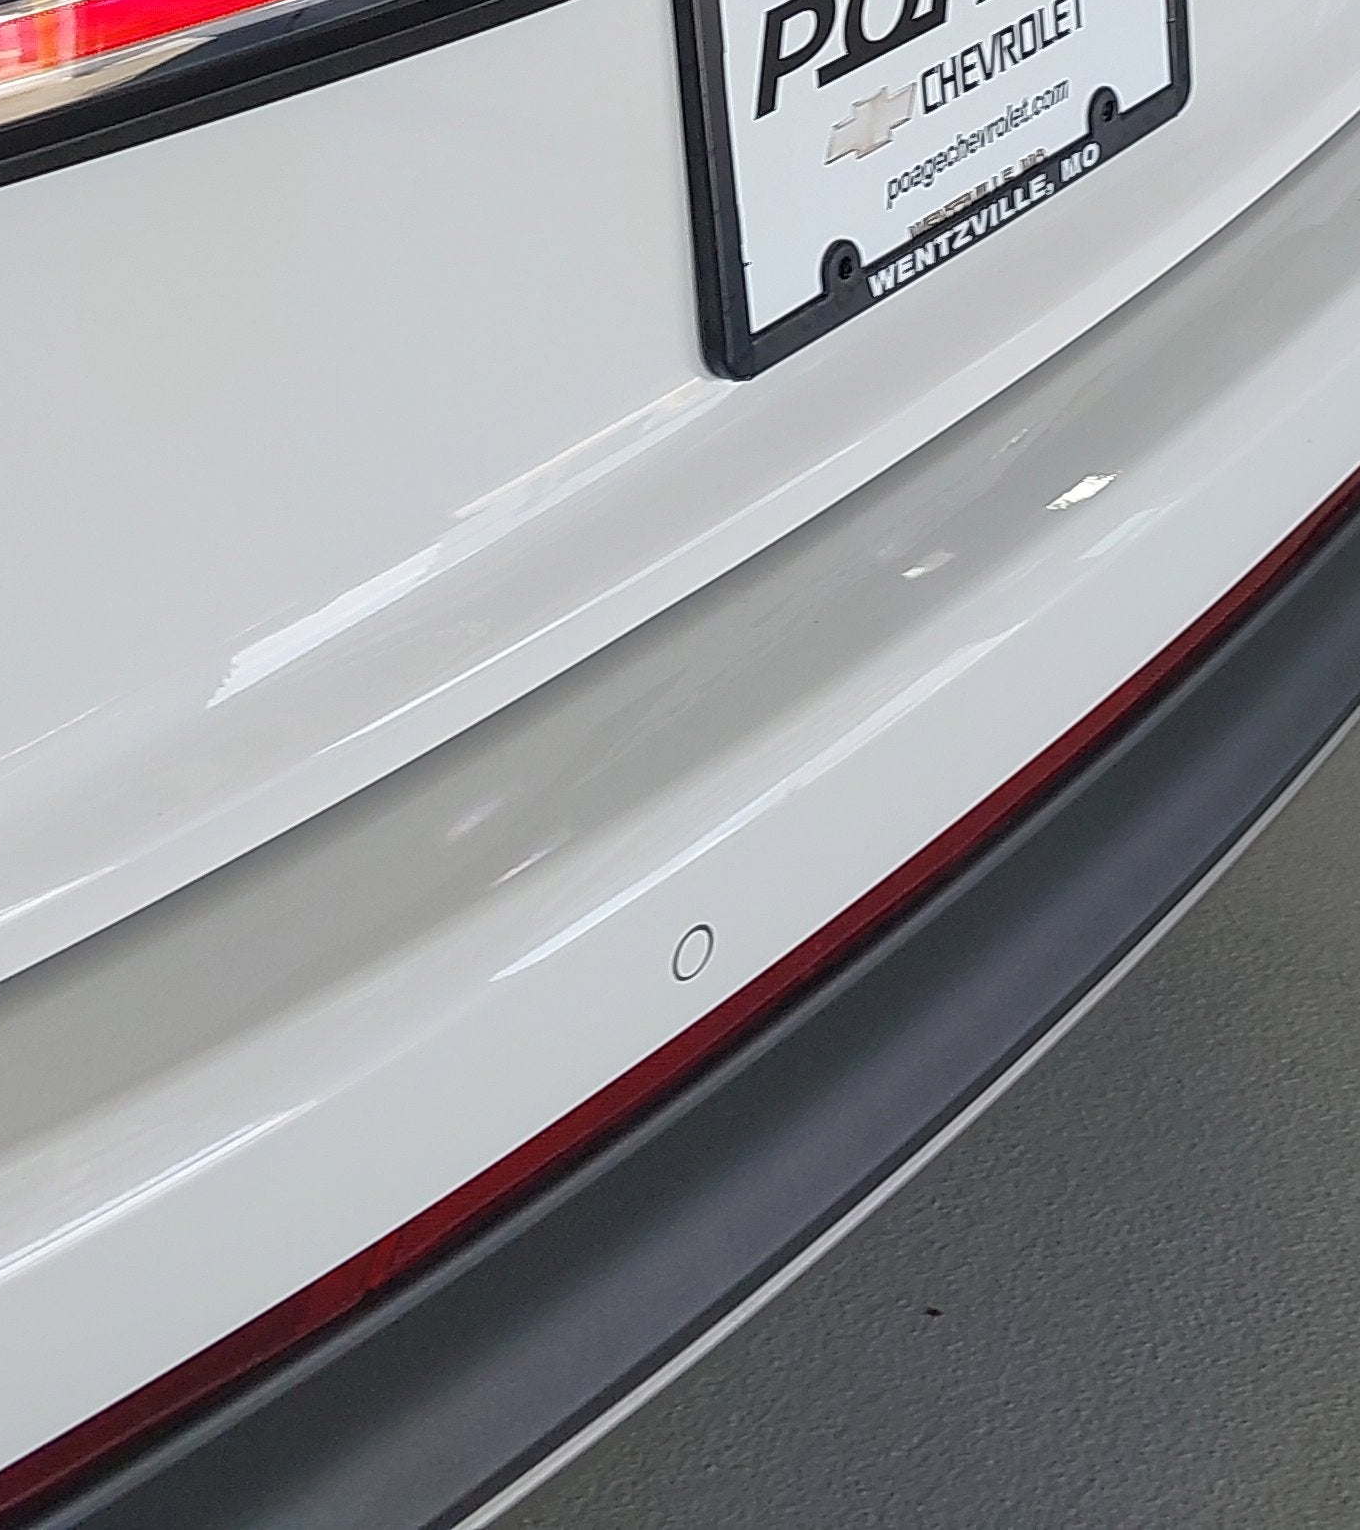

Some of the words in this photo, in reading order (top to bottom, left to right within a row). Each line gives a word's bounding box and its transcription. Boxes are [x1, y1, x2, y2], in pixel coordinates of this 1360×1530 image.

[886, 79, 1071, 211] poagechevrolet.com
[867, 172, 1056, 298] WENTZVILLE,
[1060, 142, 1102, 183] MO
